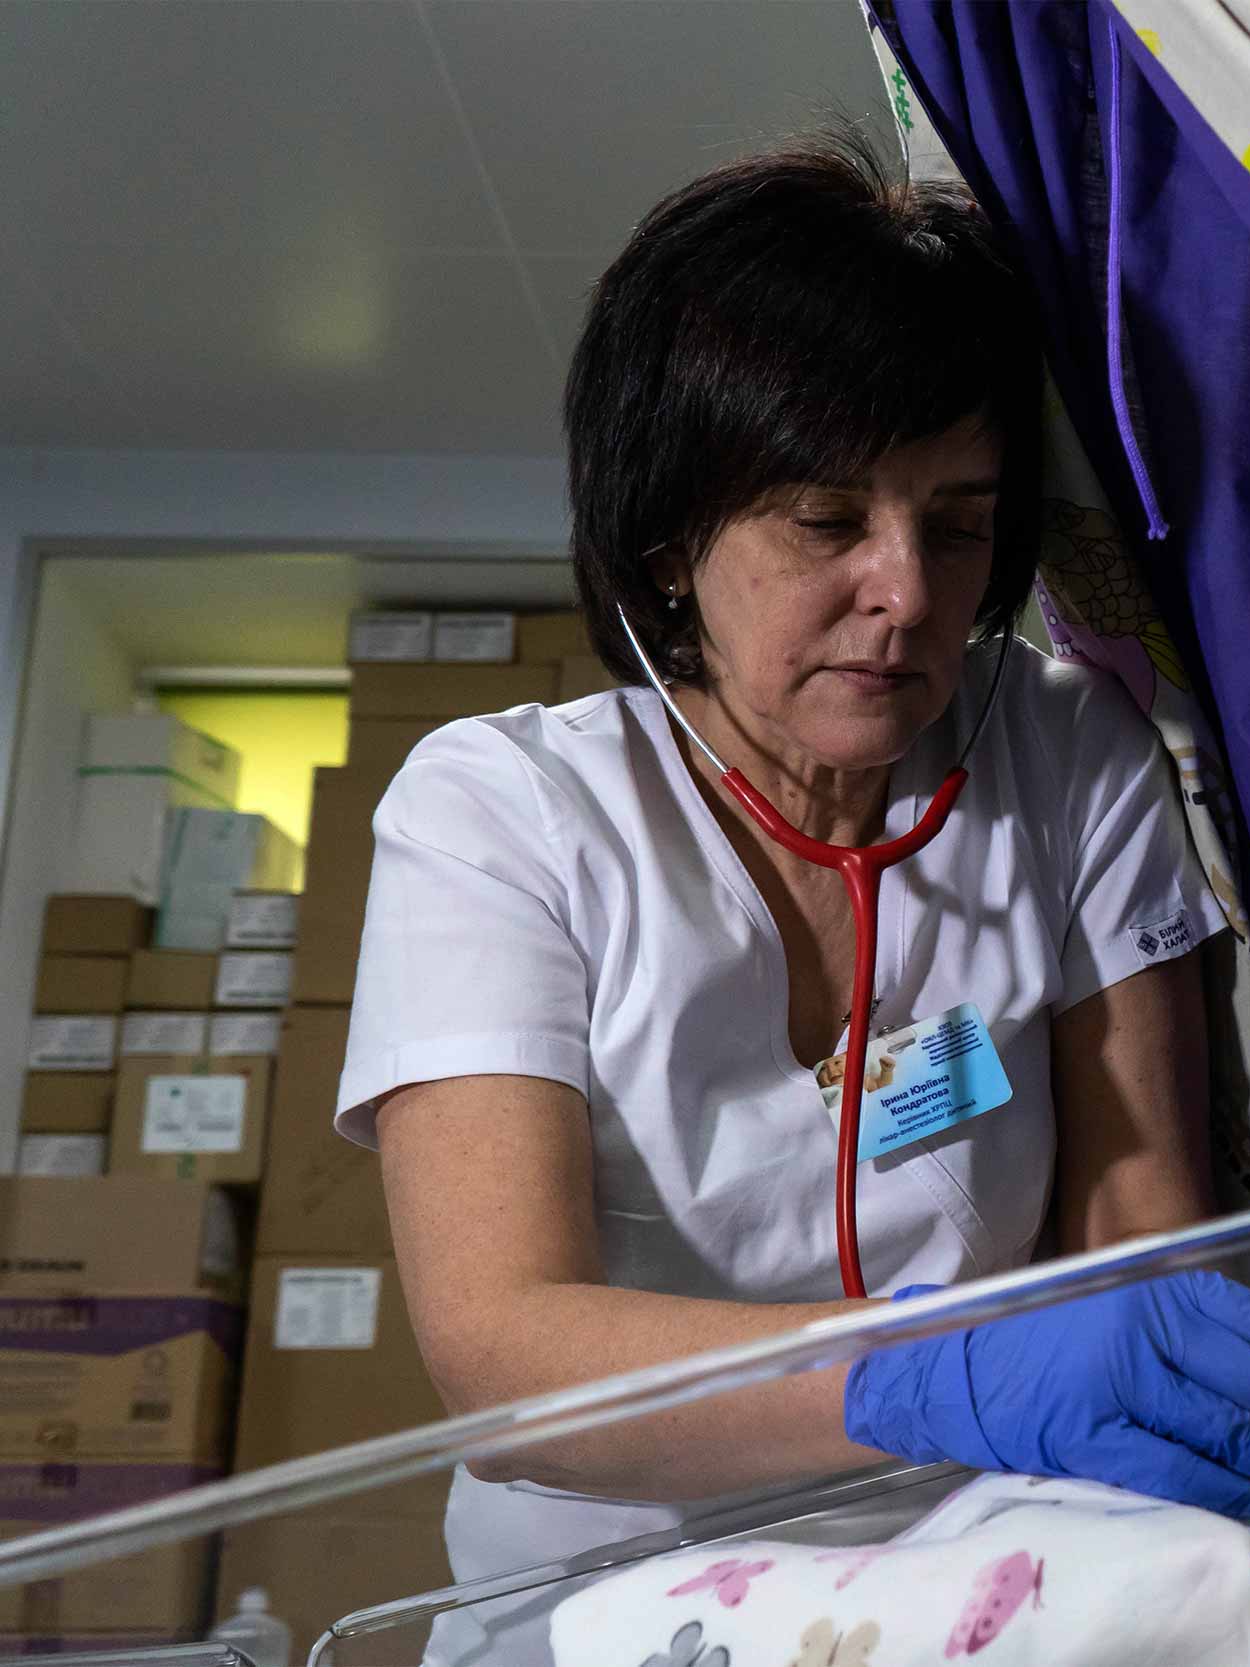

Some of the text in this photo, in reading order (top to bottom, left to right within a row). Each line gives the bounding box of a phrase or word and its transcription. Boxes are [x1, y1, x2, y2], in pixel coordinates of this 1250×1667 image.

[1158, 918, 1185, 939] БІЛИЙ
[1162, 928, 1190, 951] ХАЛАТ
[880, 1074, 950, 1108] Ірина Юріївна
[890, 1087, 950, 1117] Кондратова
